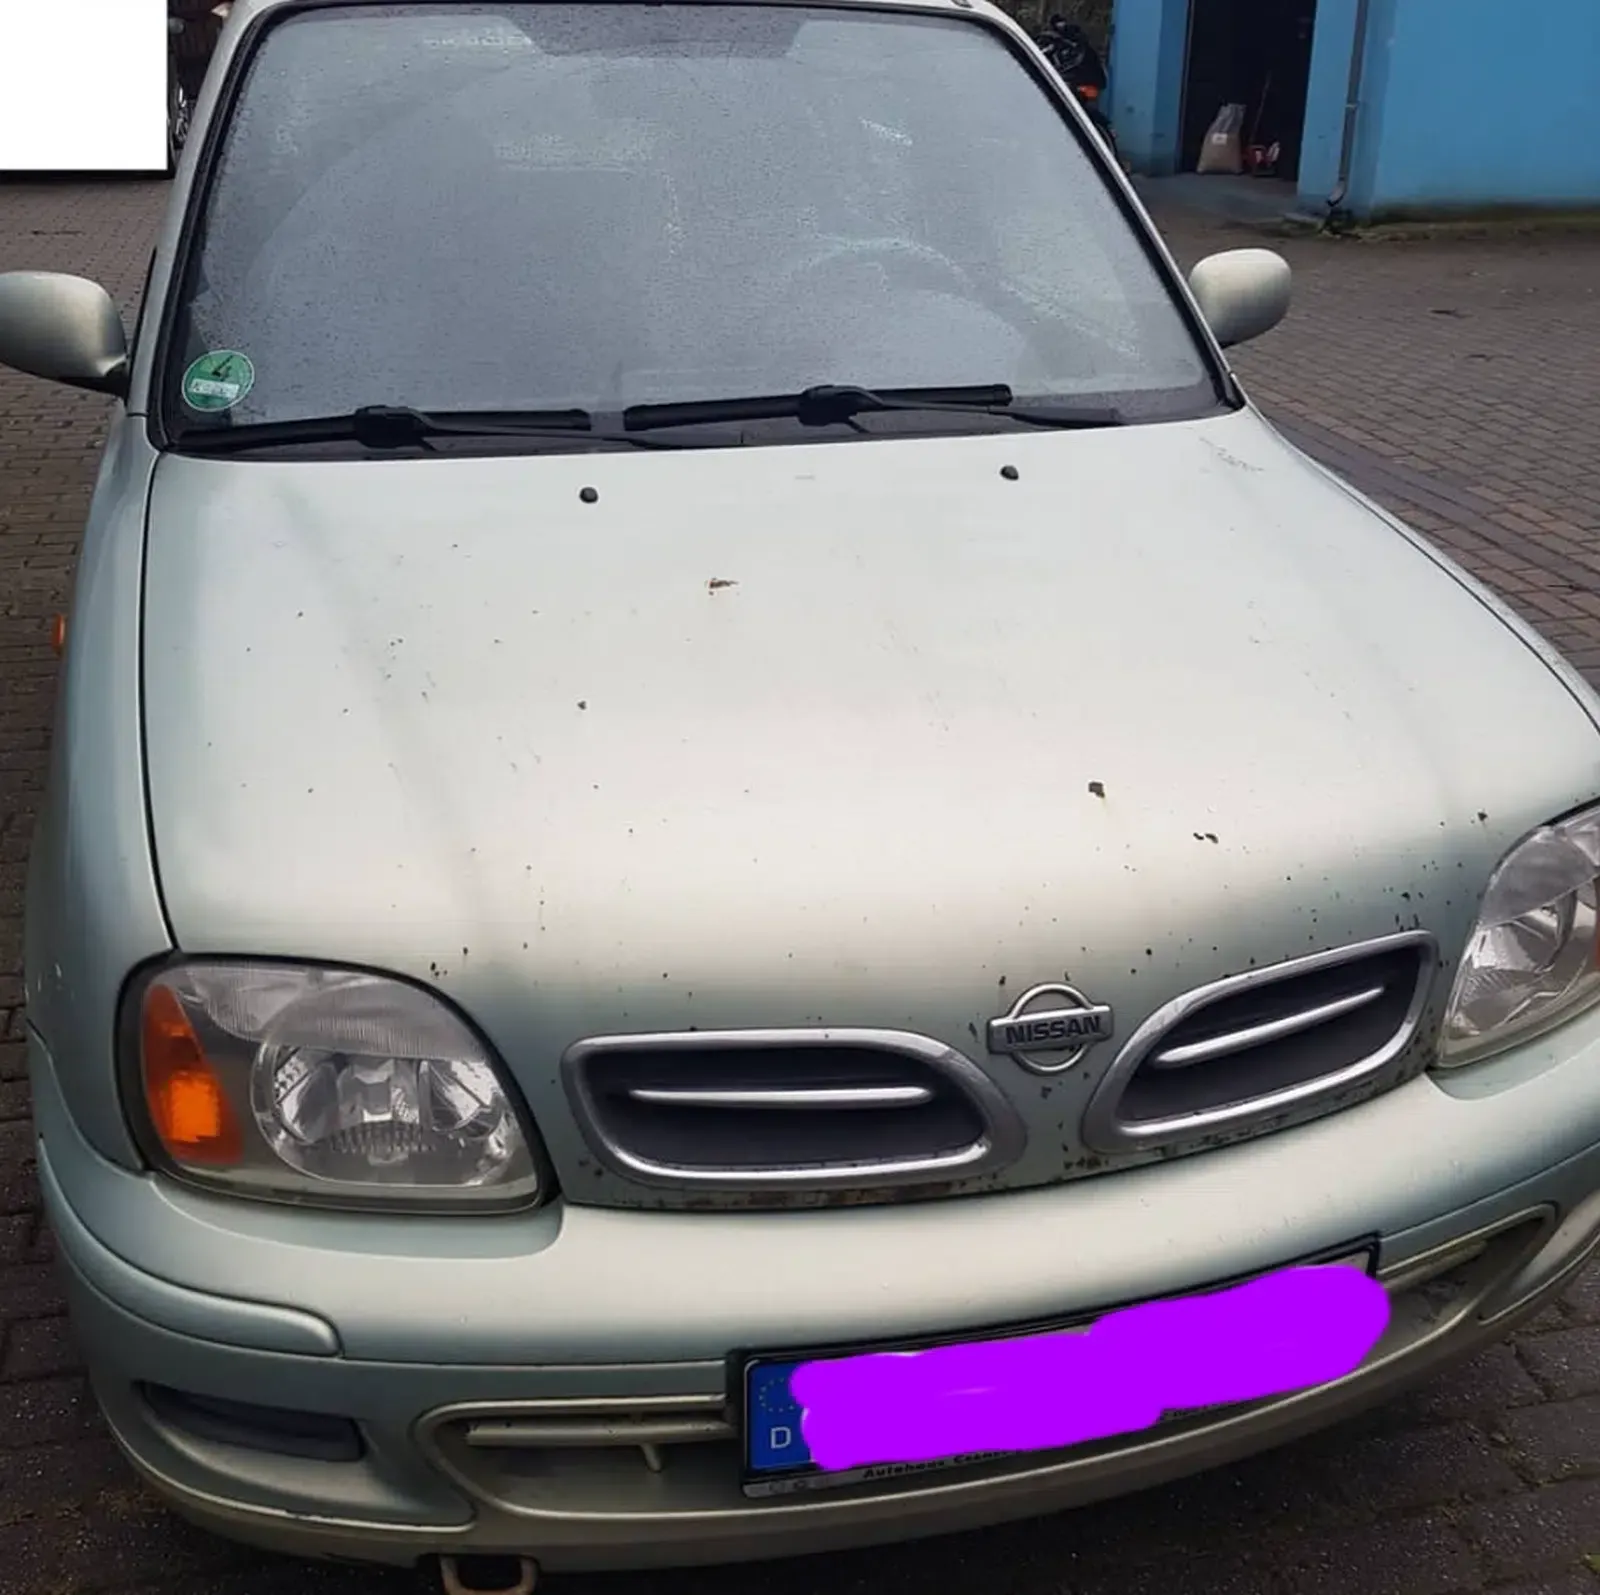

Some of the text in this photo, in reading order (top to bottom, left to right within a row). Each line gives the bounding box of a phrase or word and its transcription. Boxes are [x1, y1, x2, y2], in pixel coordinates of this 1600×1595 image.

[210, 354, 233, 382] 4
[1005, 1015, 1101, 1045] NISSAN
[770, 1426, 792, 1449] D
